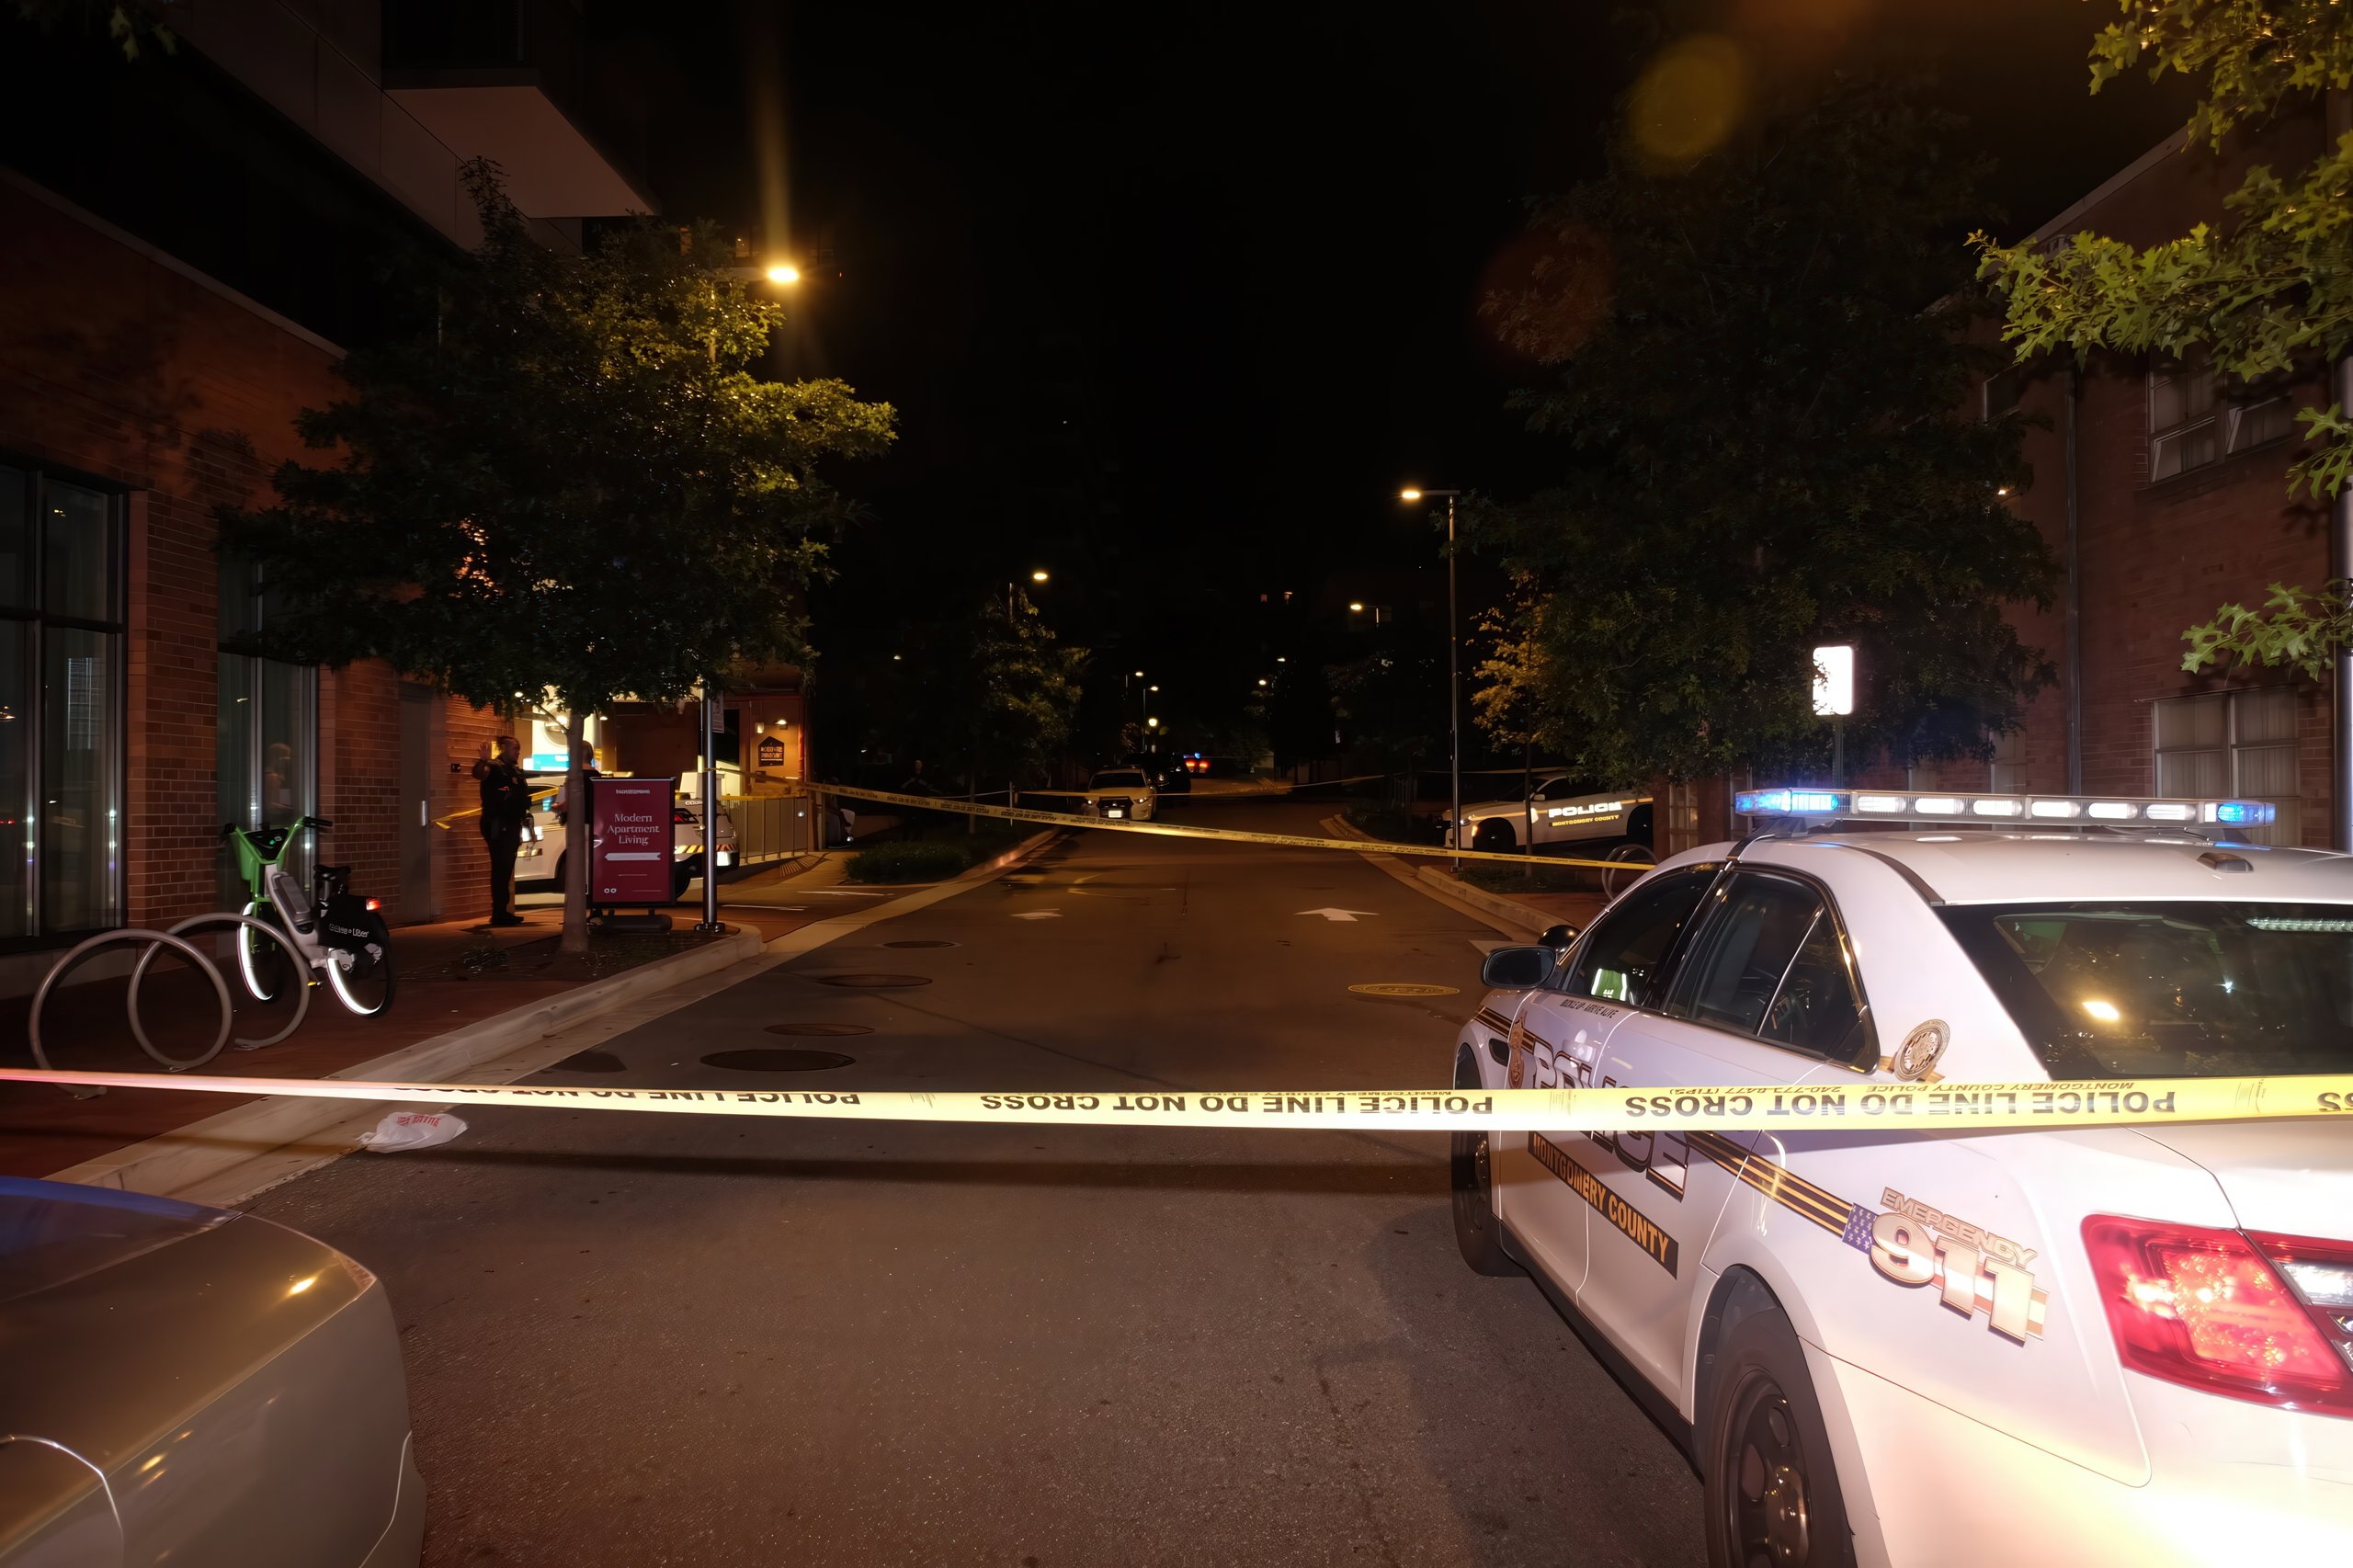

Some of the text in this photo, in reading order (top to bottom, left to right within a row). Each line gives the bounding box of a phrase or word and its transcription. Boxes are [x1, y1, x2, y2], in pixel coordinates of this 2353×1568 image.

[614, 813, 653, 823] Modern
[607, 825, 660, 835] Apartment
[619, 835, 649, 846] Living
[1867, 1085, 1929, 1093] POLICE
[1932, 1084, 2005, 1092] COUNTY
[980, 1095, 1494, 1115] POLICE LINE DO NOT CROSS
[1624, 1091, 2176, 1118] POLICE LINE DO NOT CROSS
[1608, 1194, 1670, 1264] COUNTY
[1880, 1186, 2039, 1270] EMERGENCY
[1869, 1211, 2036, 1348] 911
